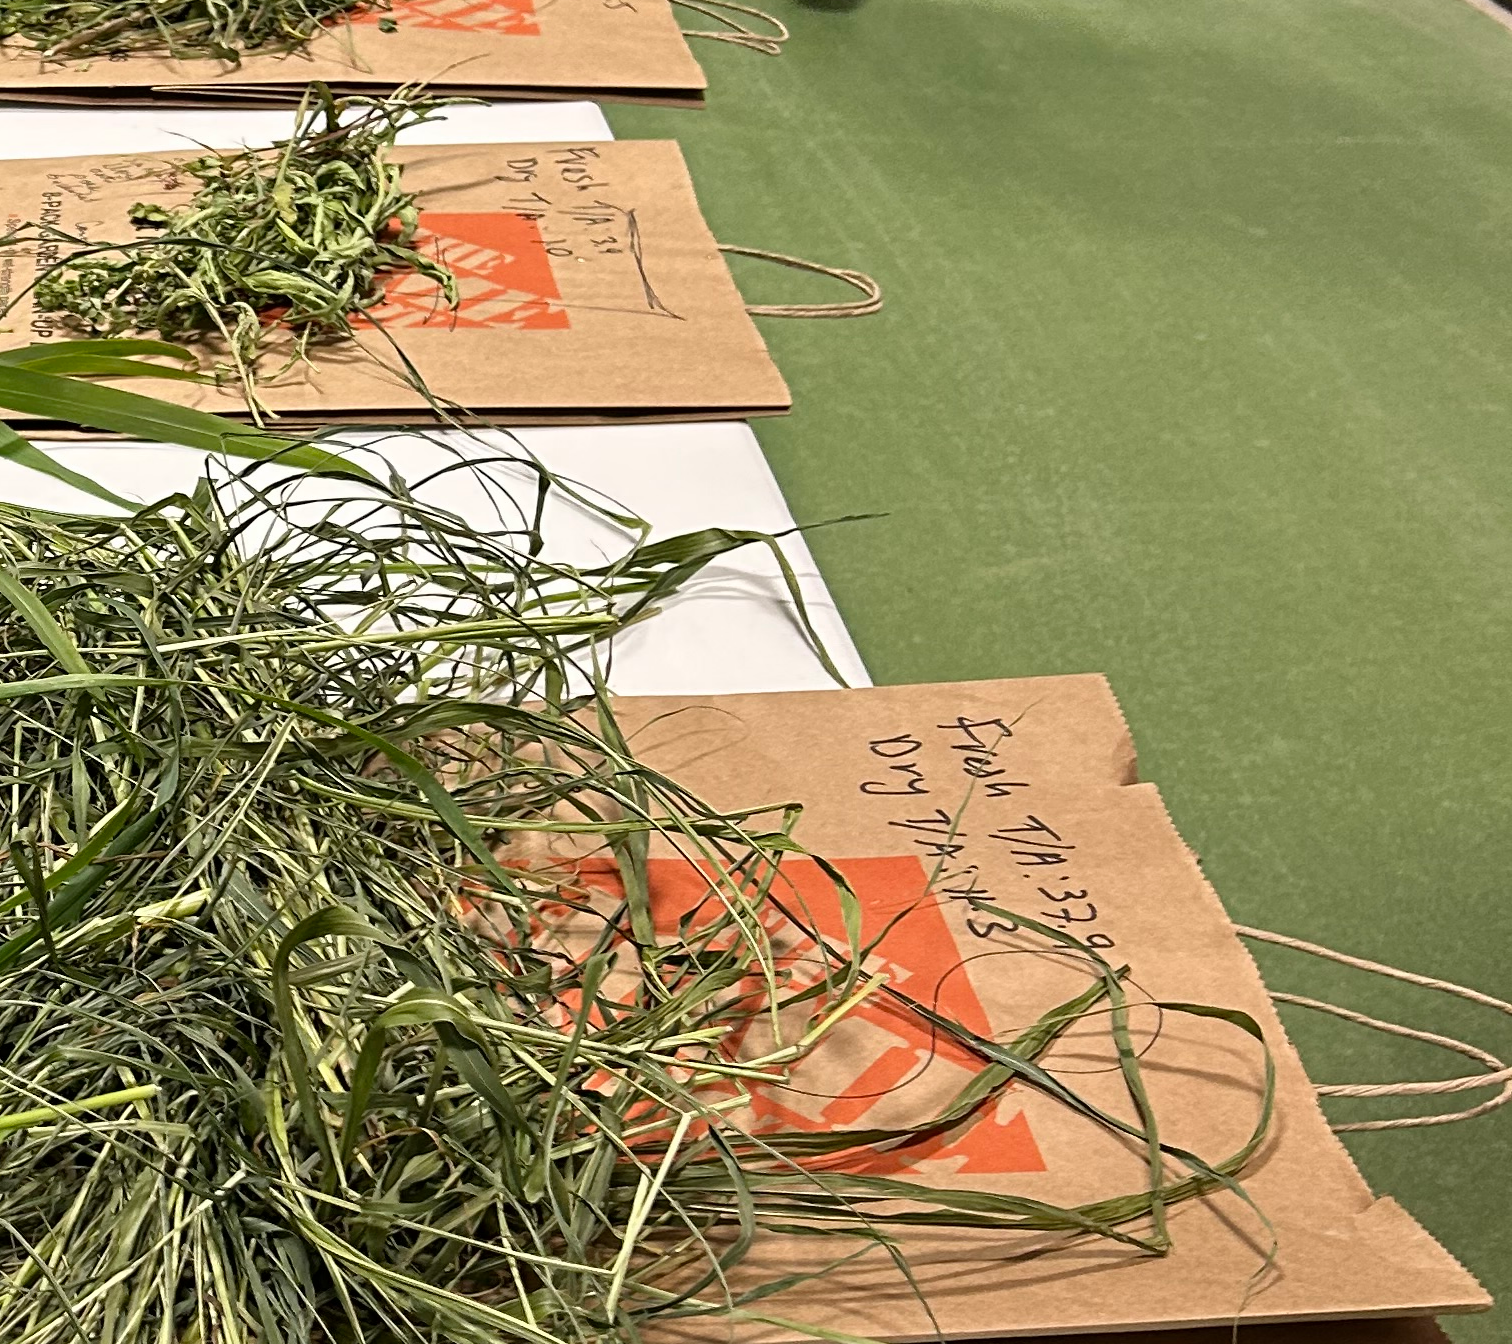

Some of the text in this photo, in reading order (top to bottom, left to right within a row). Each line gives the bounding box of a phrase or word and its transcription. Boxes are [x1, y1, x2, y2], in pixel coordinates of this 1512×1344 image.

[495, 158, 539, 182] Dry
[546, 147, 609, 191] Fresh
[40, 191, 63, 226] 8-PACK
[35, 231, 61, 272] GARDEN
[859, 734, 931, 796] Dry
[937, 717, 1029, 797] Fresh
